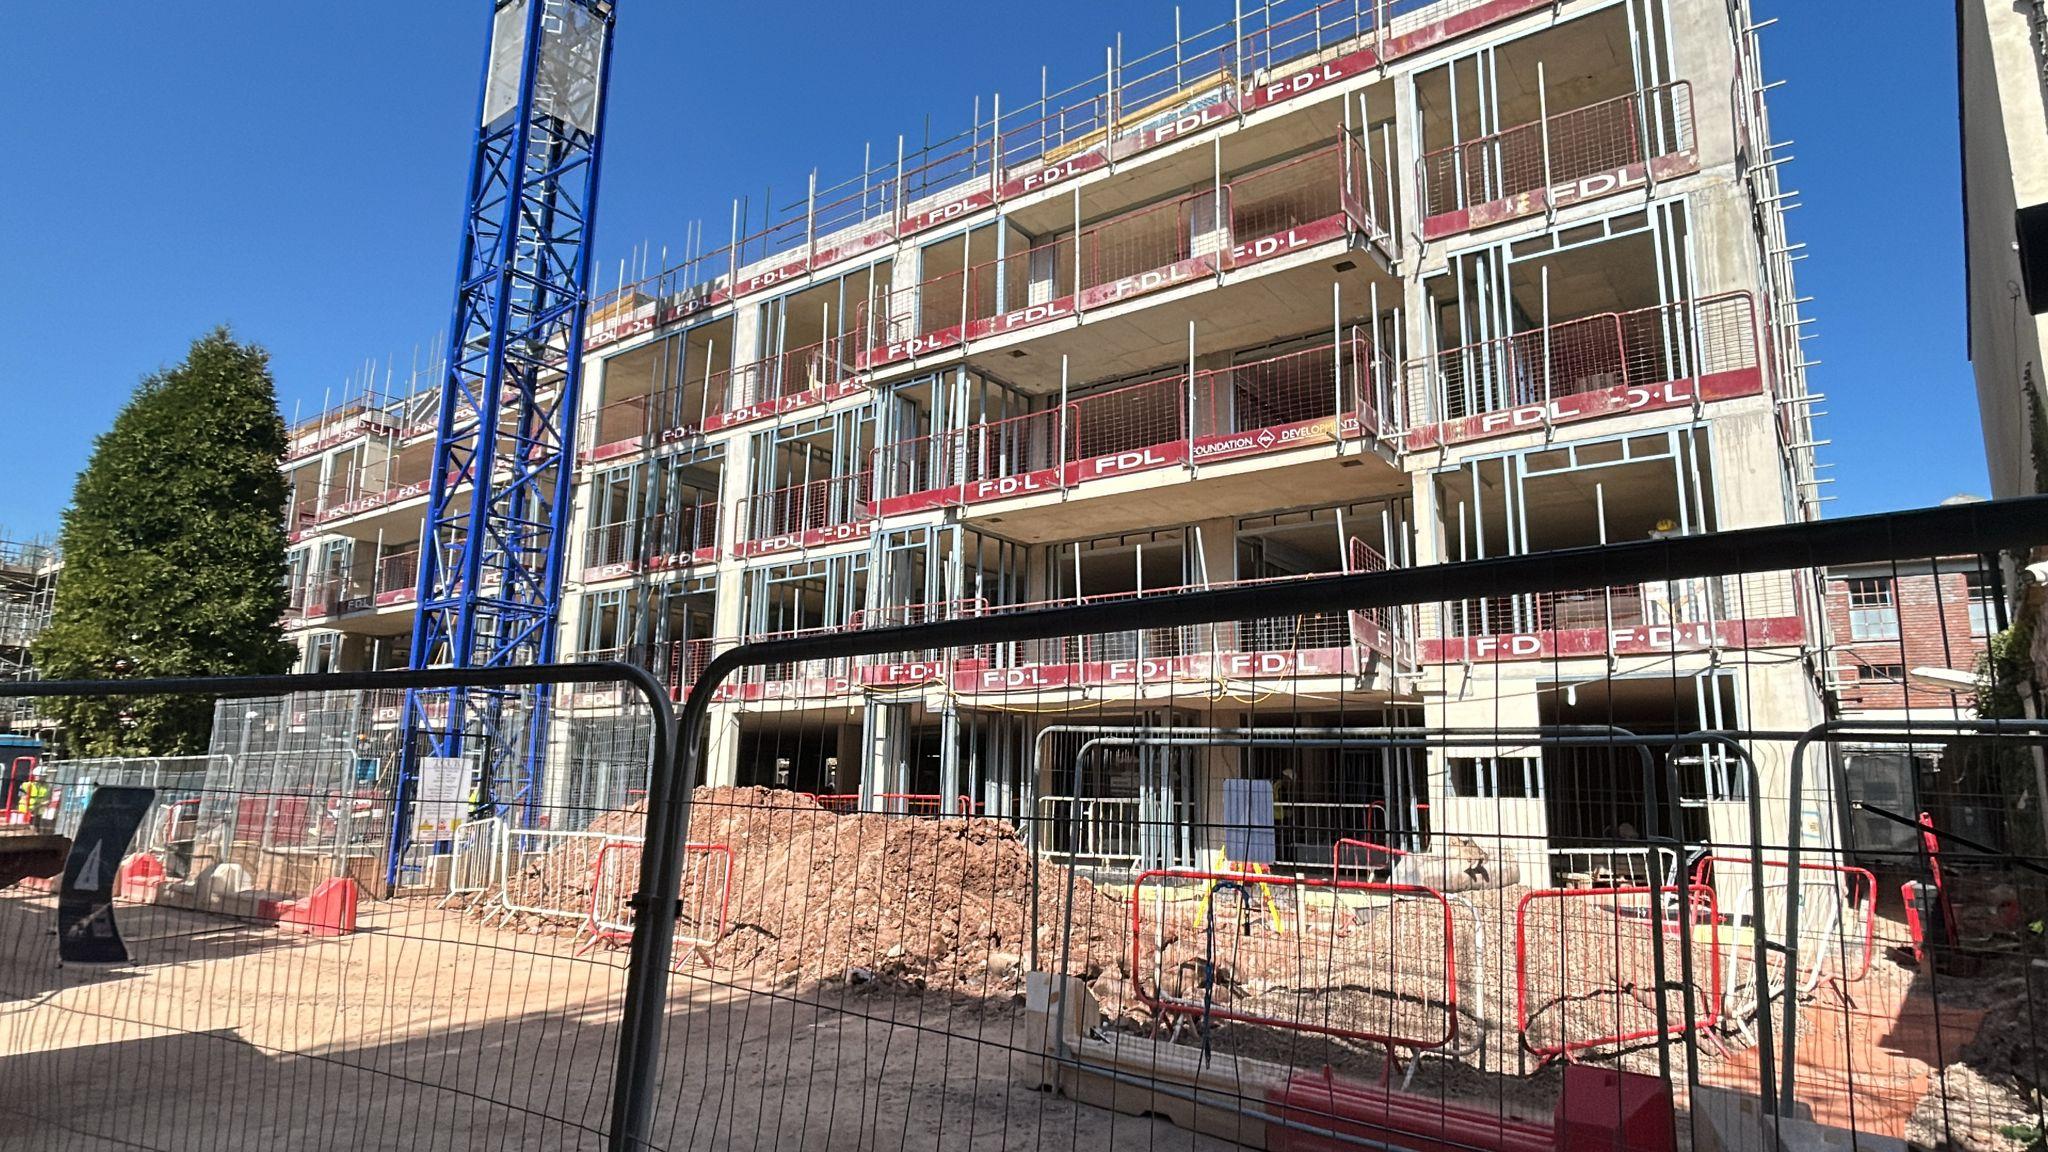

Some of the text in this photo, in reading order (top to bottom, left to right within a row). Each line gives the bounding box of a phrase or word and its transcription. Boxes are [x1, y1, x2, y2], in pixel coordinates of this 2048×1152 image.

[1155, 110, 1222, 143] FDL
[1551, 168, 1647, 205] FDL
[928, 199, 978, 225] FDL
[1005, 303, 1066, 328] FDL
[1482, 401, 1580, 433] FDL
[1095, 449, 1165, 474] FDL
[760, 535, 801, 552] FDL
